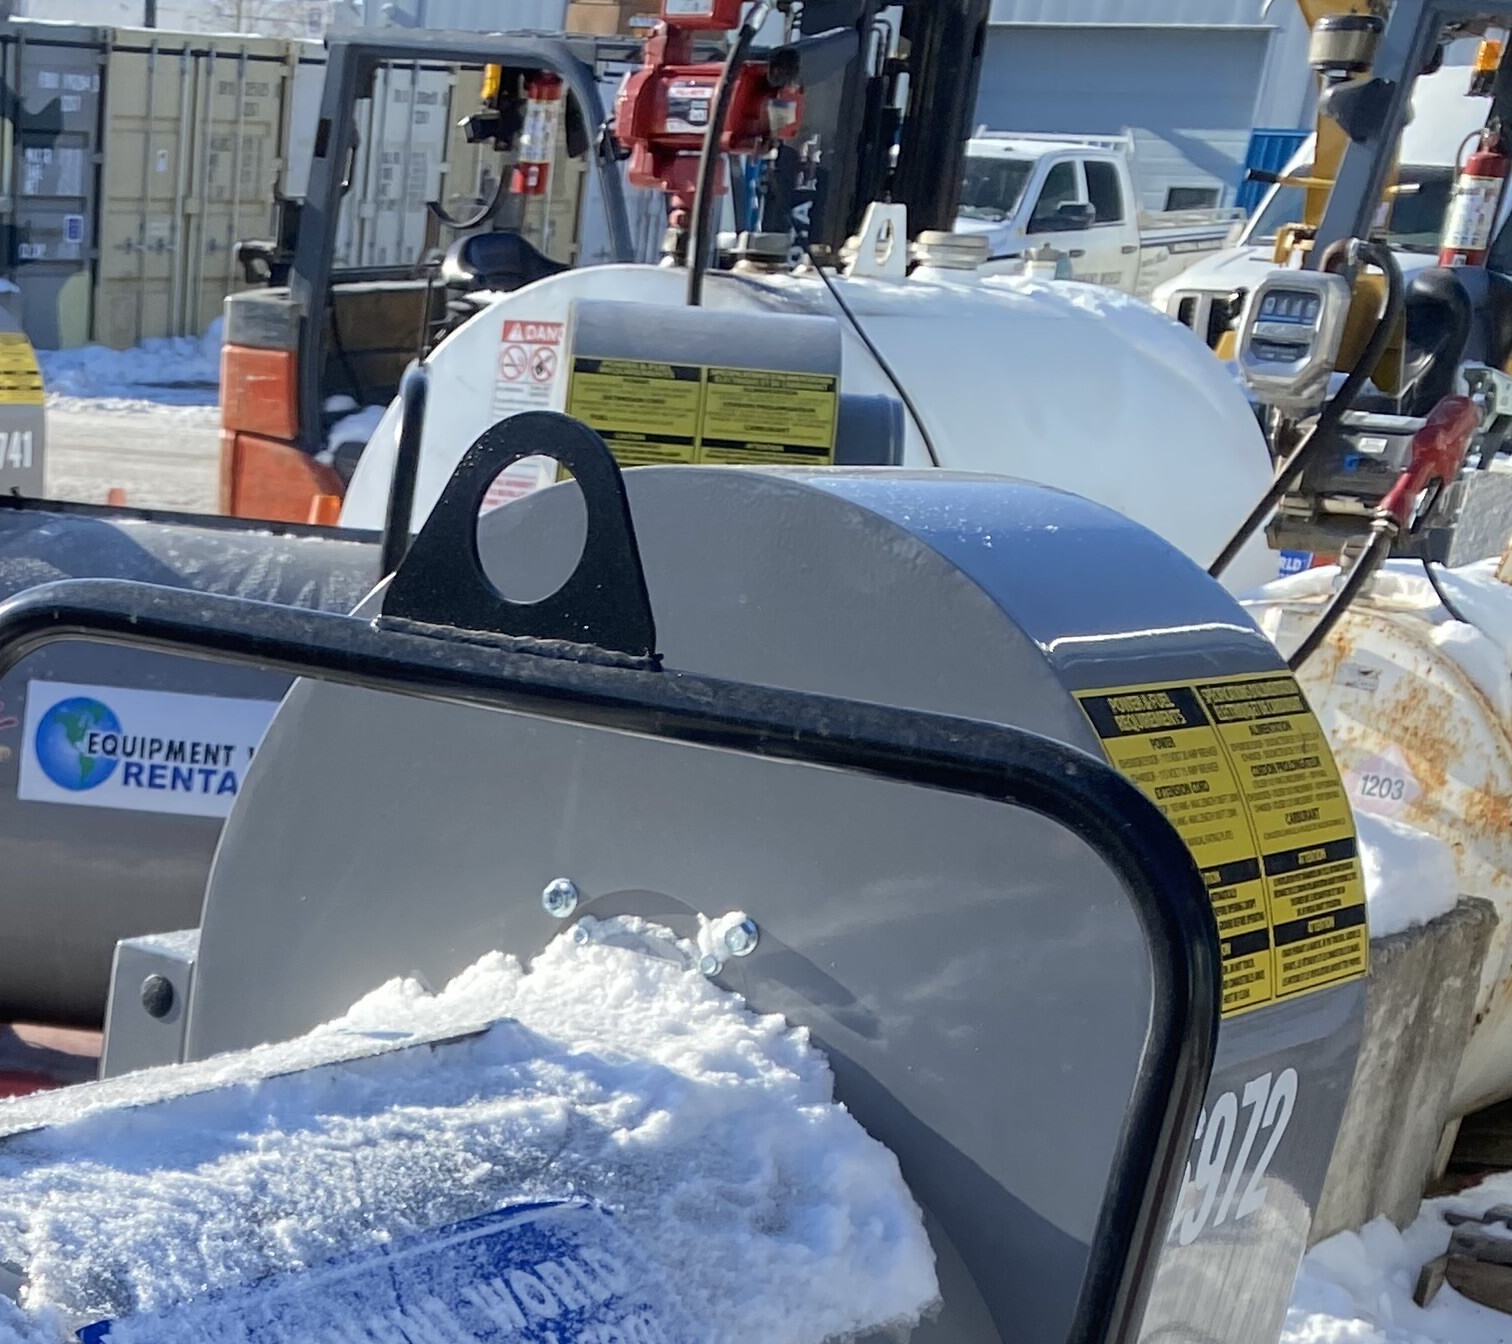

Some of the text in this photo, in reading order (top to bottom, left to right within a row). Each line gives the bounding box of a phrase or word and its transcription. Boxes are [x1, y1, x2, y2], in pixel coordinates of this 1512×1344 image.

[87, 731, 237, 768] EQUIPMENT
[1361, 774, 1404, 800] 1203
[1168, 1067, 1299, 1247] 972
[457, 1239, 639, 1338] WORLD
